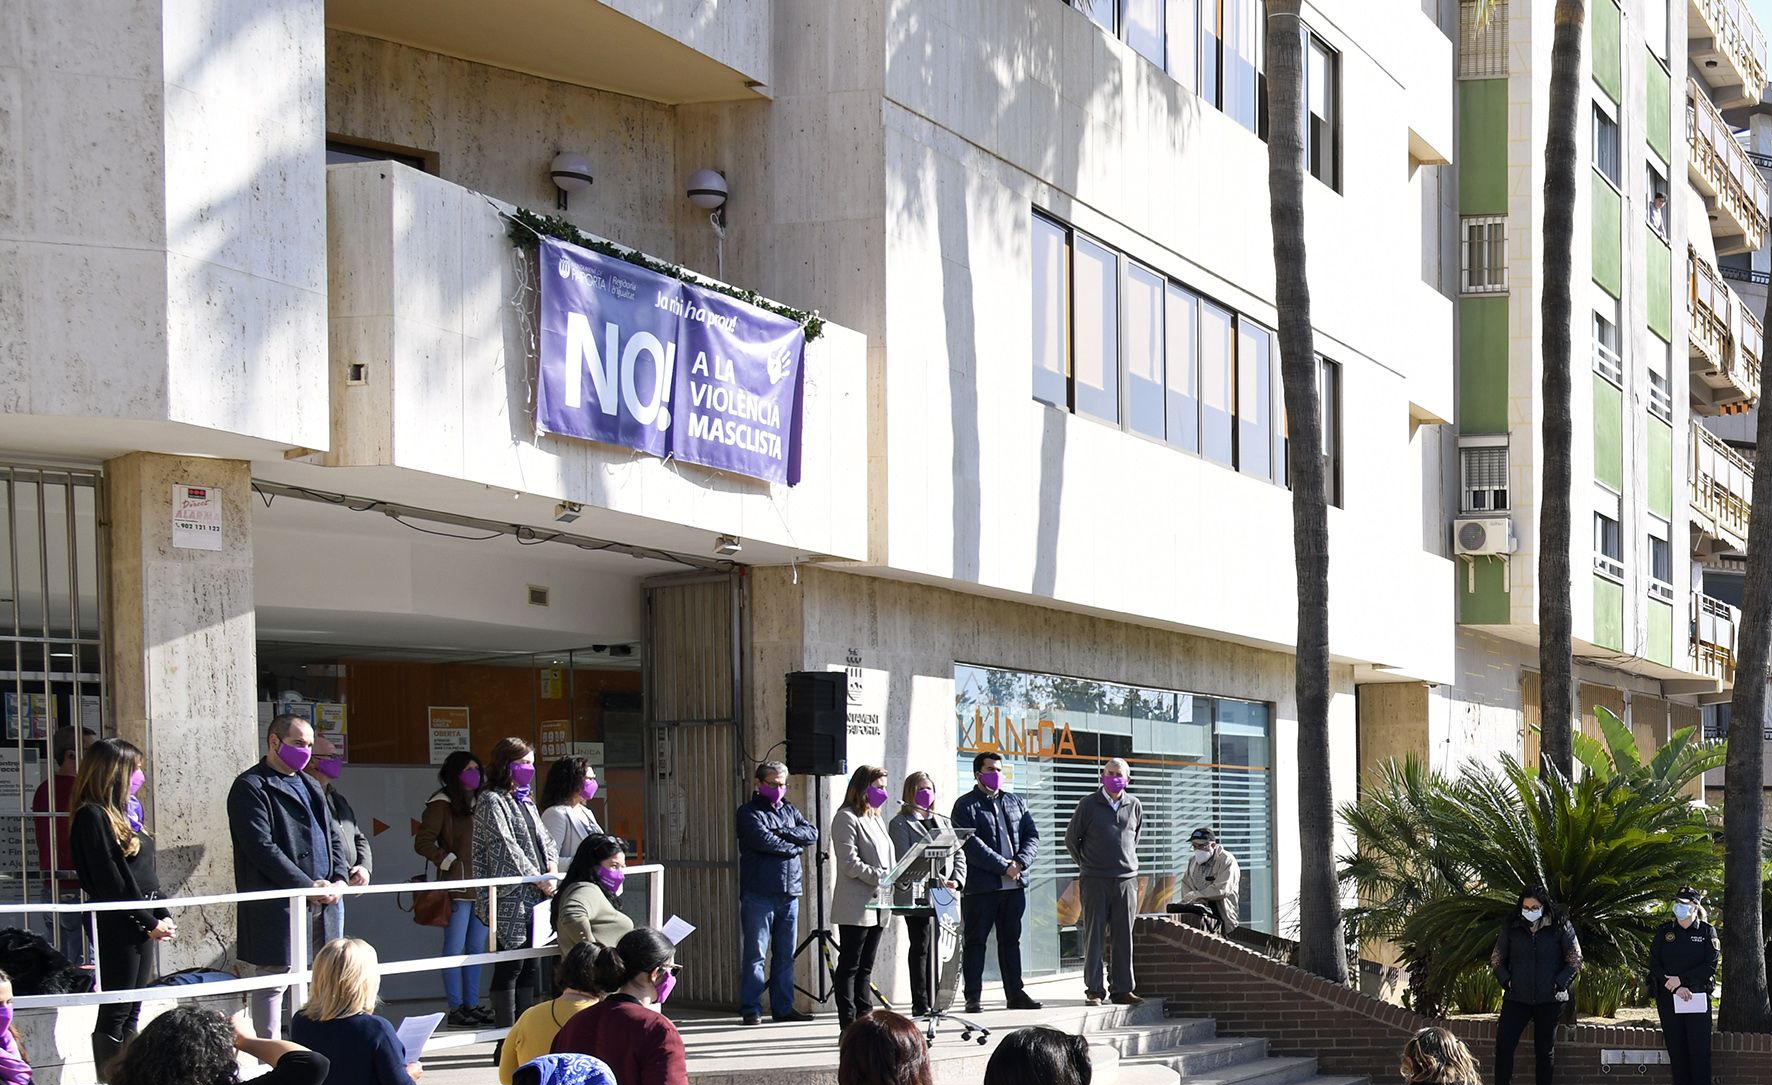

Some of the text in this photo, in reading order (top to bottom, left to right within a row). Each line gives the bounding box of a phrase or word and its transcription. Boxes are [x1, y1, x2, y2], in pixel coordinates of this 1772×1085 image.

[654, 290, 668, 310] Ja
[684, 300, 706, 322] ha
[706, 311, 738, 333] prou!
[564, 311, 676, 432] NO!
[691, 351, 736, 385] A LA
[690, 380, 781, 430] VIOLÈNCIA
[688, 412, 782, 460] MASCLISTA
